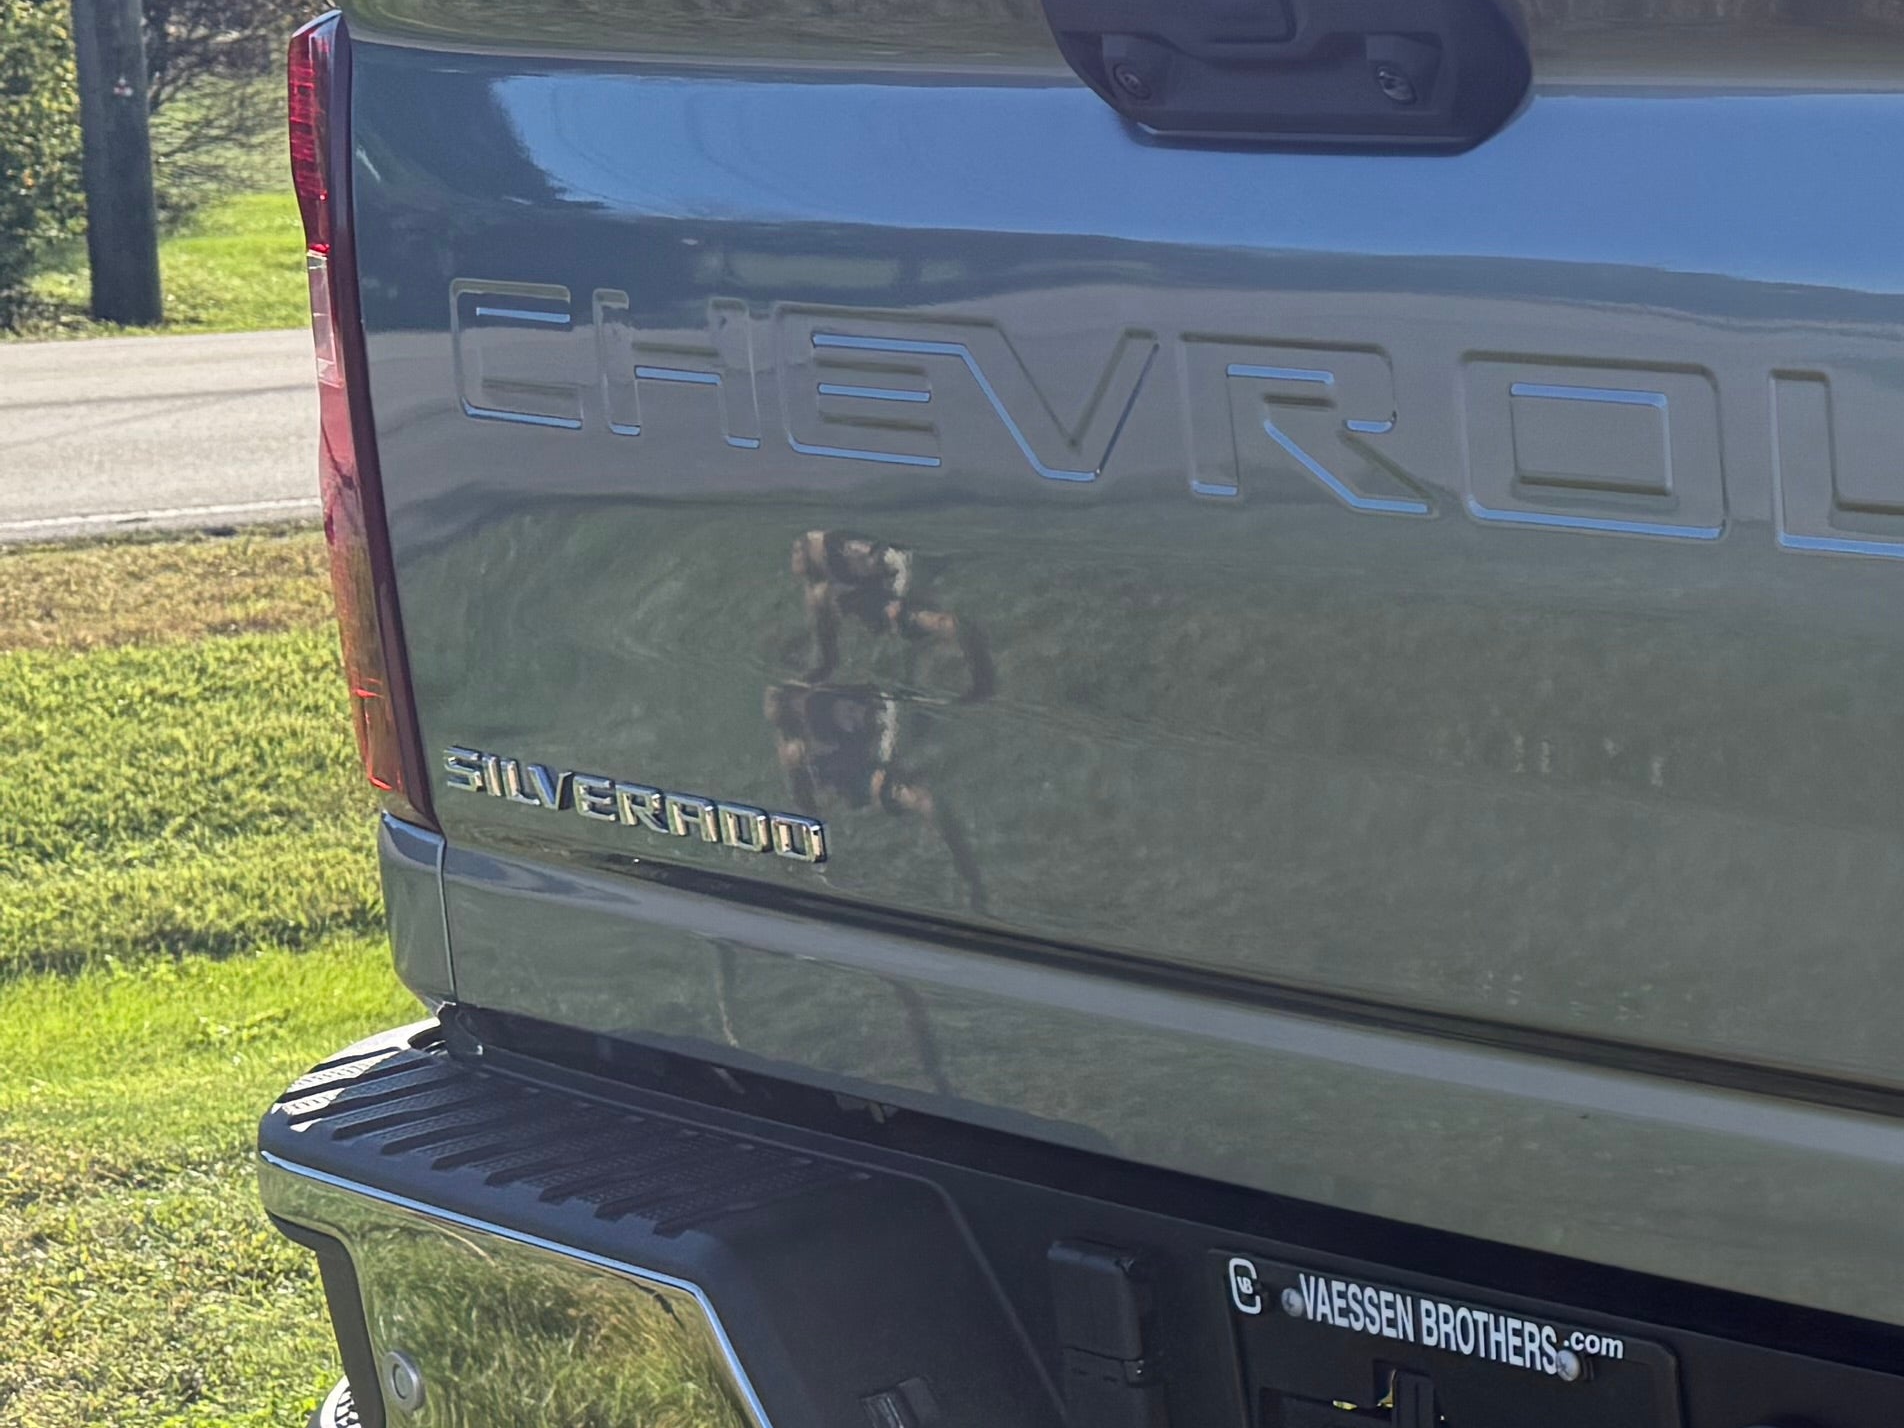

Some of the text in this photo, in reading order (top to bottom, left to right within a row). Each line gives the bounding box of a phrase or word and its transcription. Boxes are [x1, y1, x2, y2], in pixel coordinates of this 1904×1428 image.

[443, 745, 828, 863] SILVERADO
[1299, 1273, 1624, 1376] VAESSEN BROTHERS .com
